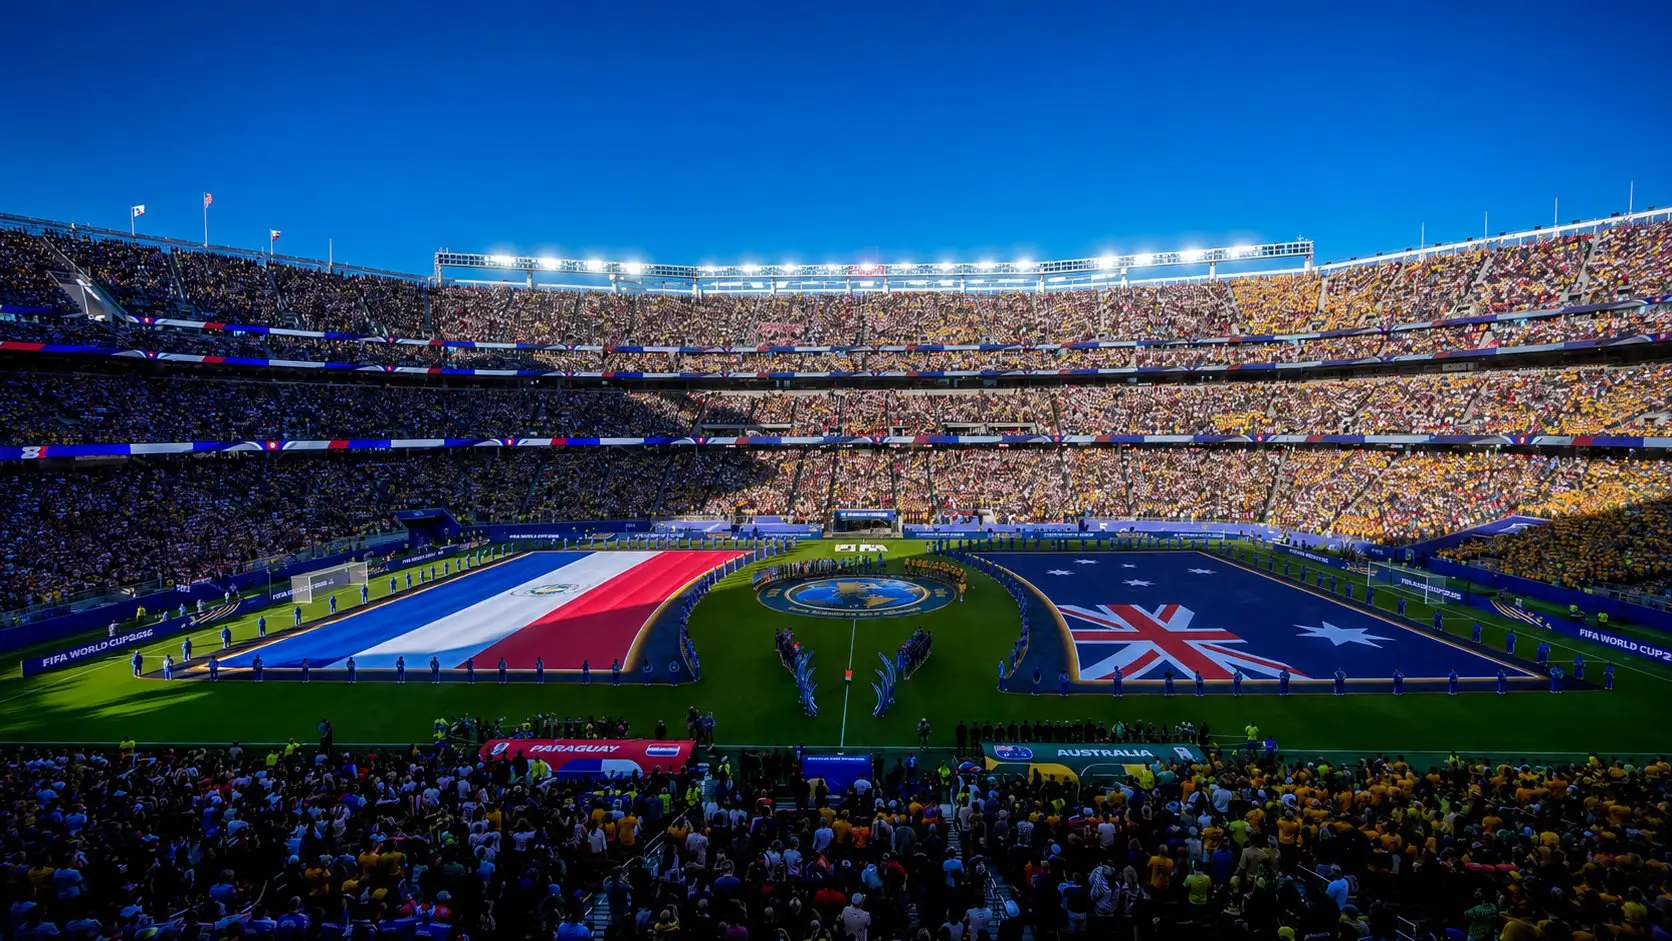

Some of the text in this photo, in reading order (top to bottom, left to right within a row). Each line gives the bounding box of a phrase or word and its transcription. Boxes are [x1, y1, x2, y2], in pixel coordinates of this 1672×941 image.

[43, 653, 68, 667] FIFA
[70, 642, 108, 658] WORLD
[109, 635, 129, 647] CUP
[1580, 628, 1599, 641] FIFA
[1600, 634, 1638, 651] WORLD
[1639, 645, 1662, 658] CUP
[529, 744, 620, 753] PARAGUAY
[1057, 748, 1154, 758] AUSTRALIA
